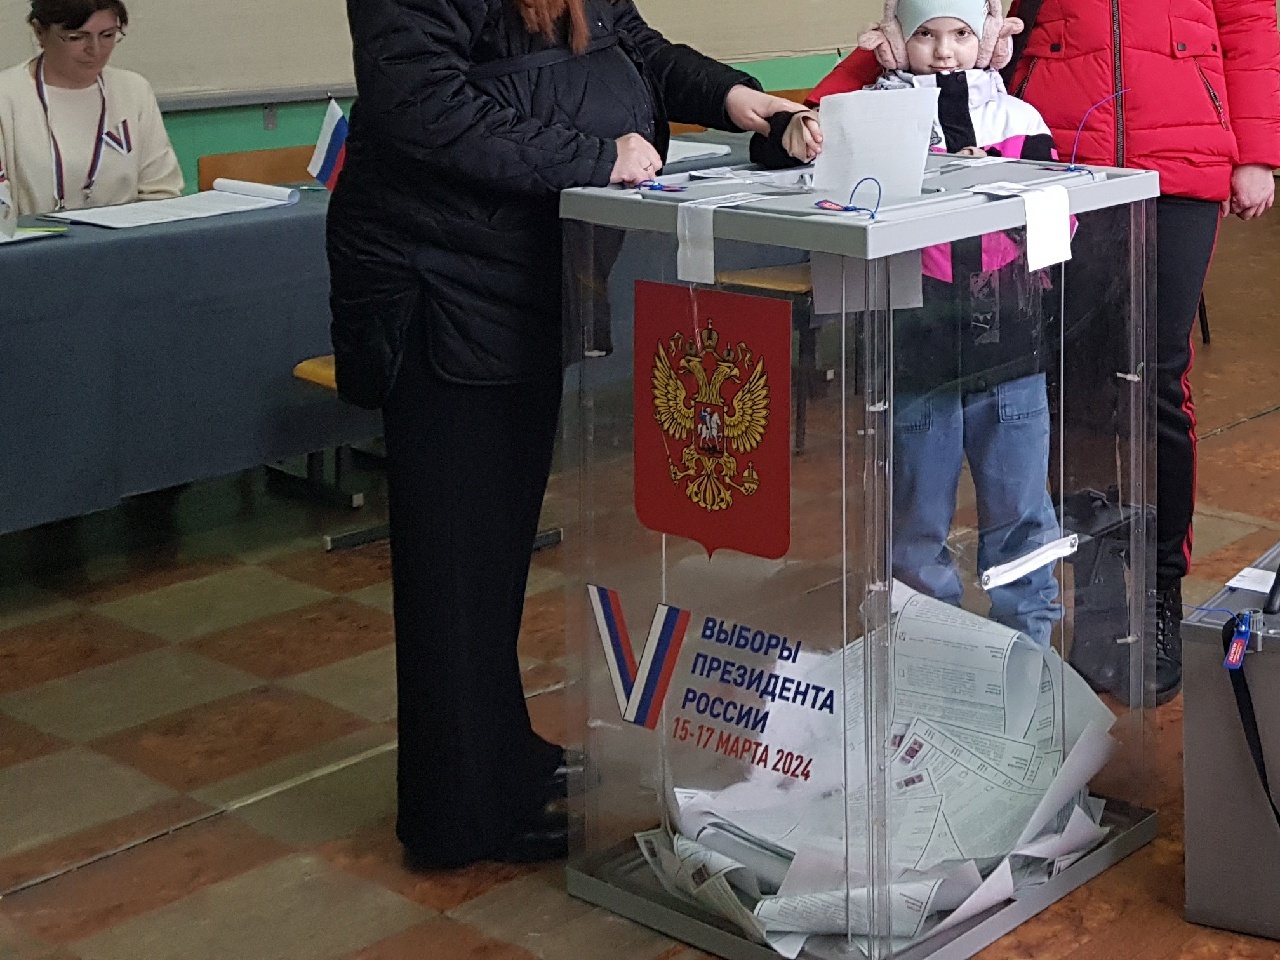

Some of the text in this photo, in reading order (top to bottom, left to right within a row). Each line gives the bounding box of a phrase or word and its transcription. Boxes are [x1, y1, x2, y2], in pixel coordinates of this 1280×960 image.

[701, 616, 801, 663] ВЫБОРЫ
[681, 687, 769, 733] РОССИИ
[691, 652, 835, 714] ПРЕЗИДЕНТА
[672, 716, 814, 782] 15-17 МАРТА 2024
